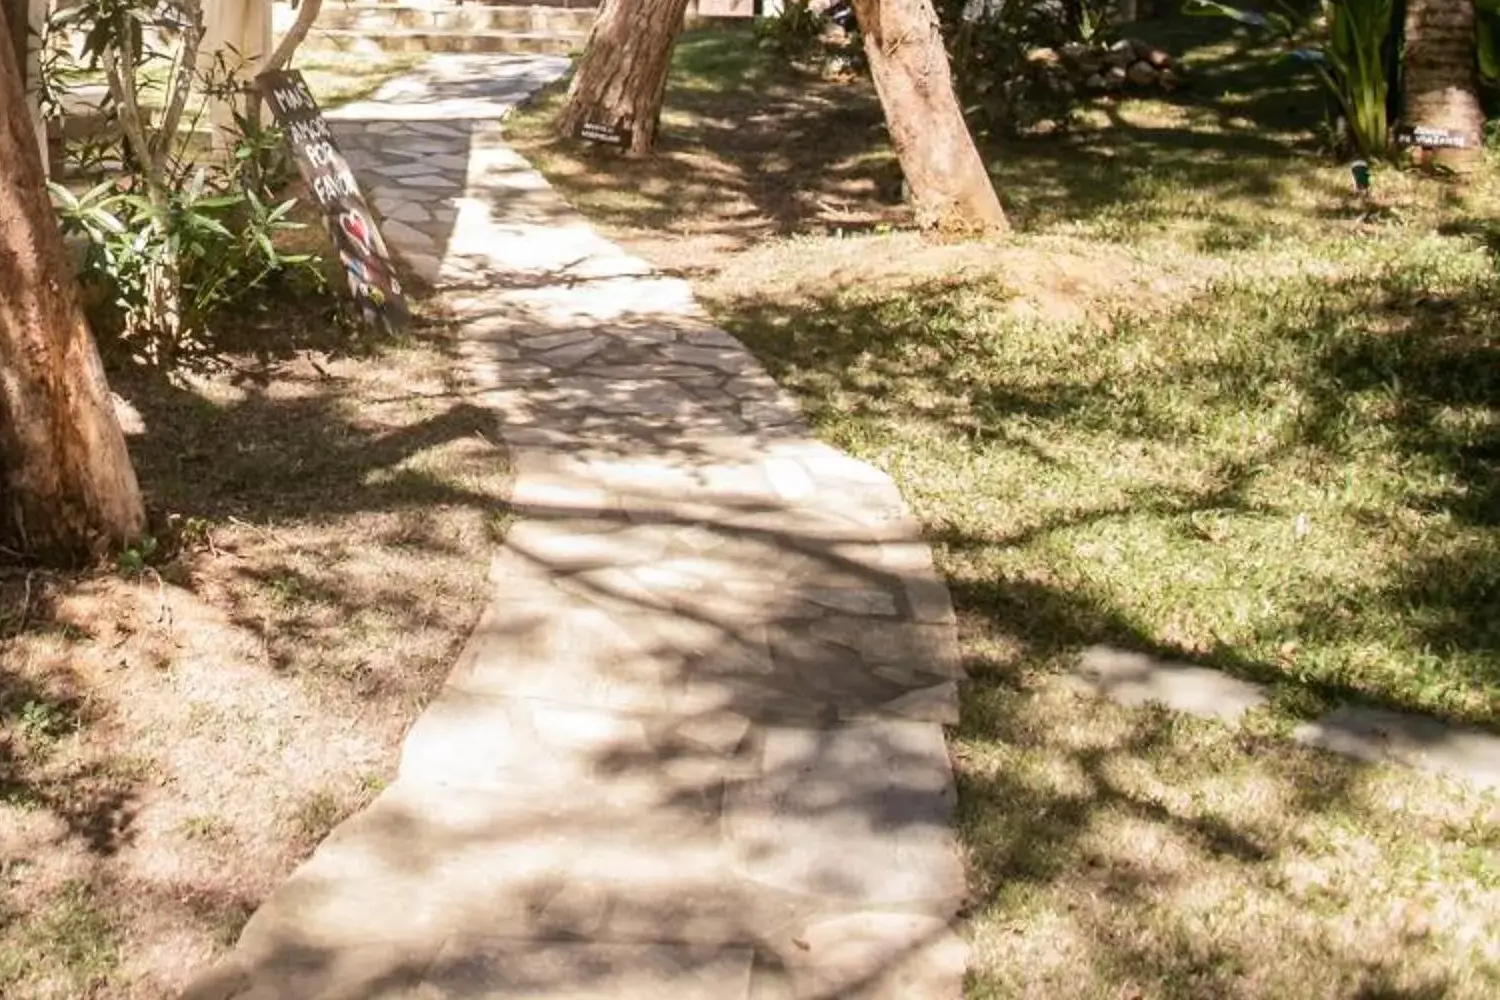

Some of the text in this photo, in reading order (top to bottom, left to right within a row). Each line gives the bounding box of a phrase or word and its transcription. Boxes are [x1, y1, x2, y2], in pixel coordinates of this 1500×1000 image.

[273, 82, 315, 113] MAIS
[290, 116, 331, 144] AMOR
[305, 141, 333, 169] POR
